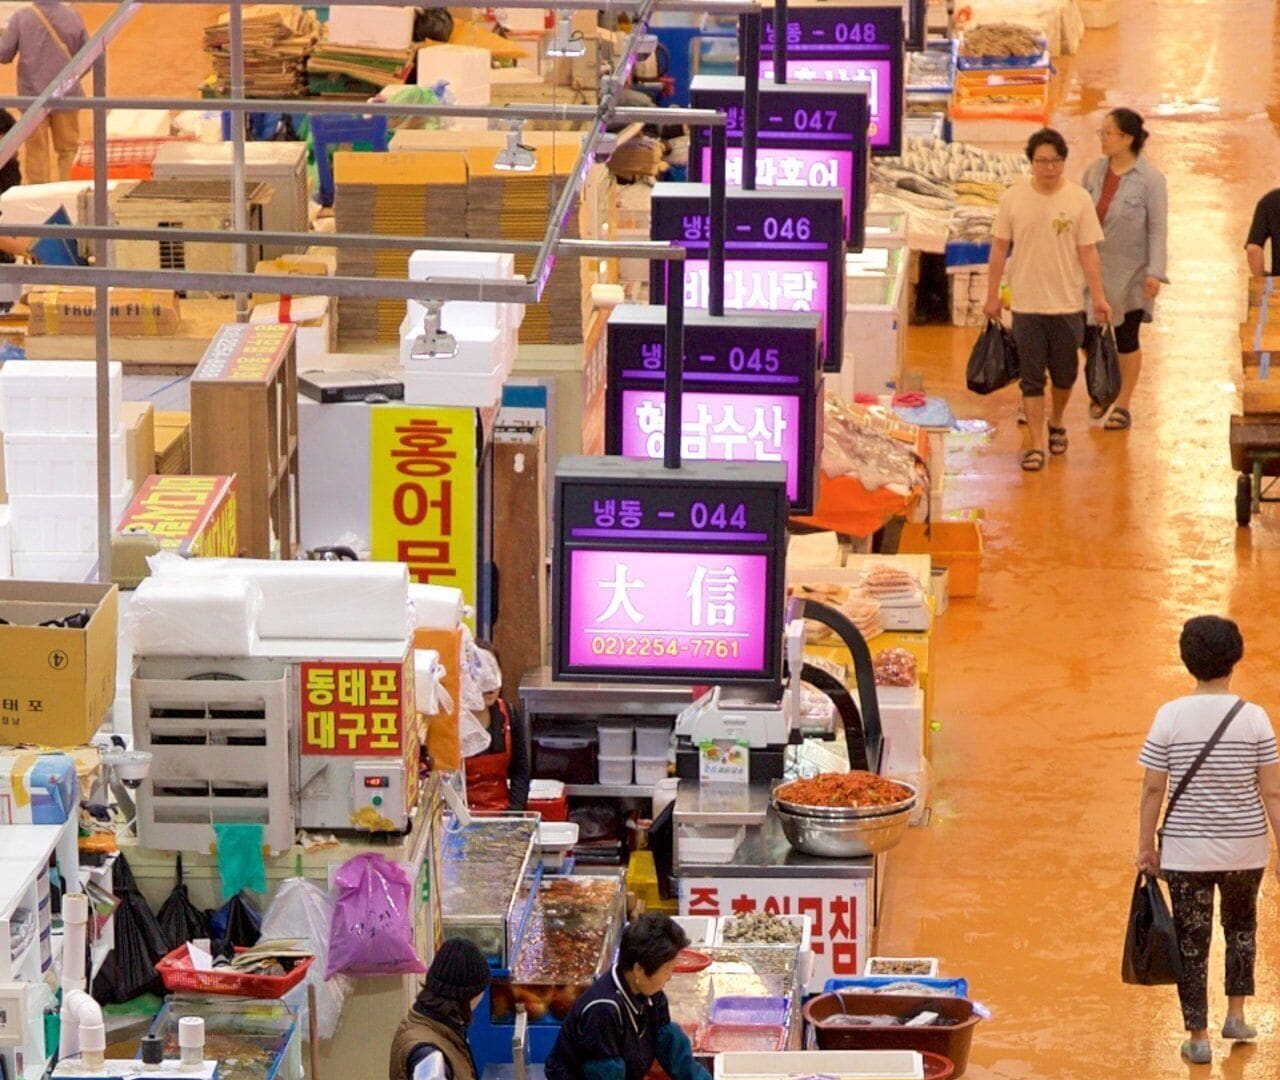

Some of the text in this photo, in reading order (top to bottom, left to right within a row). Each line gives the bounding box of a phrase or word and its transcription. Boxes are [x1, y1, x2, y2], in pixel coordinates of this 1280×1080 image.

[835, 22, 876, 43] 048
[794, 109, 837, 131] 047
[682, 215, 711, 239] 냉
[763, 217, 810, 240] 046
[728, 347, 780, 372] 045
[391, 418, 457, 587] 홍어무
[593, 499, 643, 528] 냉동
[690, 502, 747, 529] 044
[595, 562, 740, 627] 大信
[591, 636, 739, 659] 02)2254-7761
[306, 668, 399, 707] 동태포
[306, 710, 400, 749] 대구포
